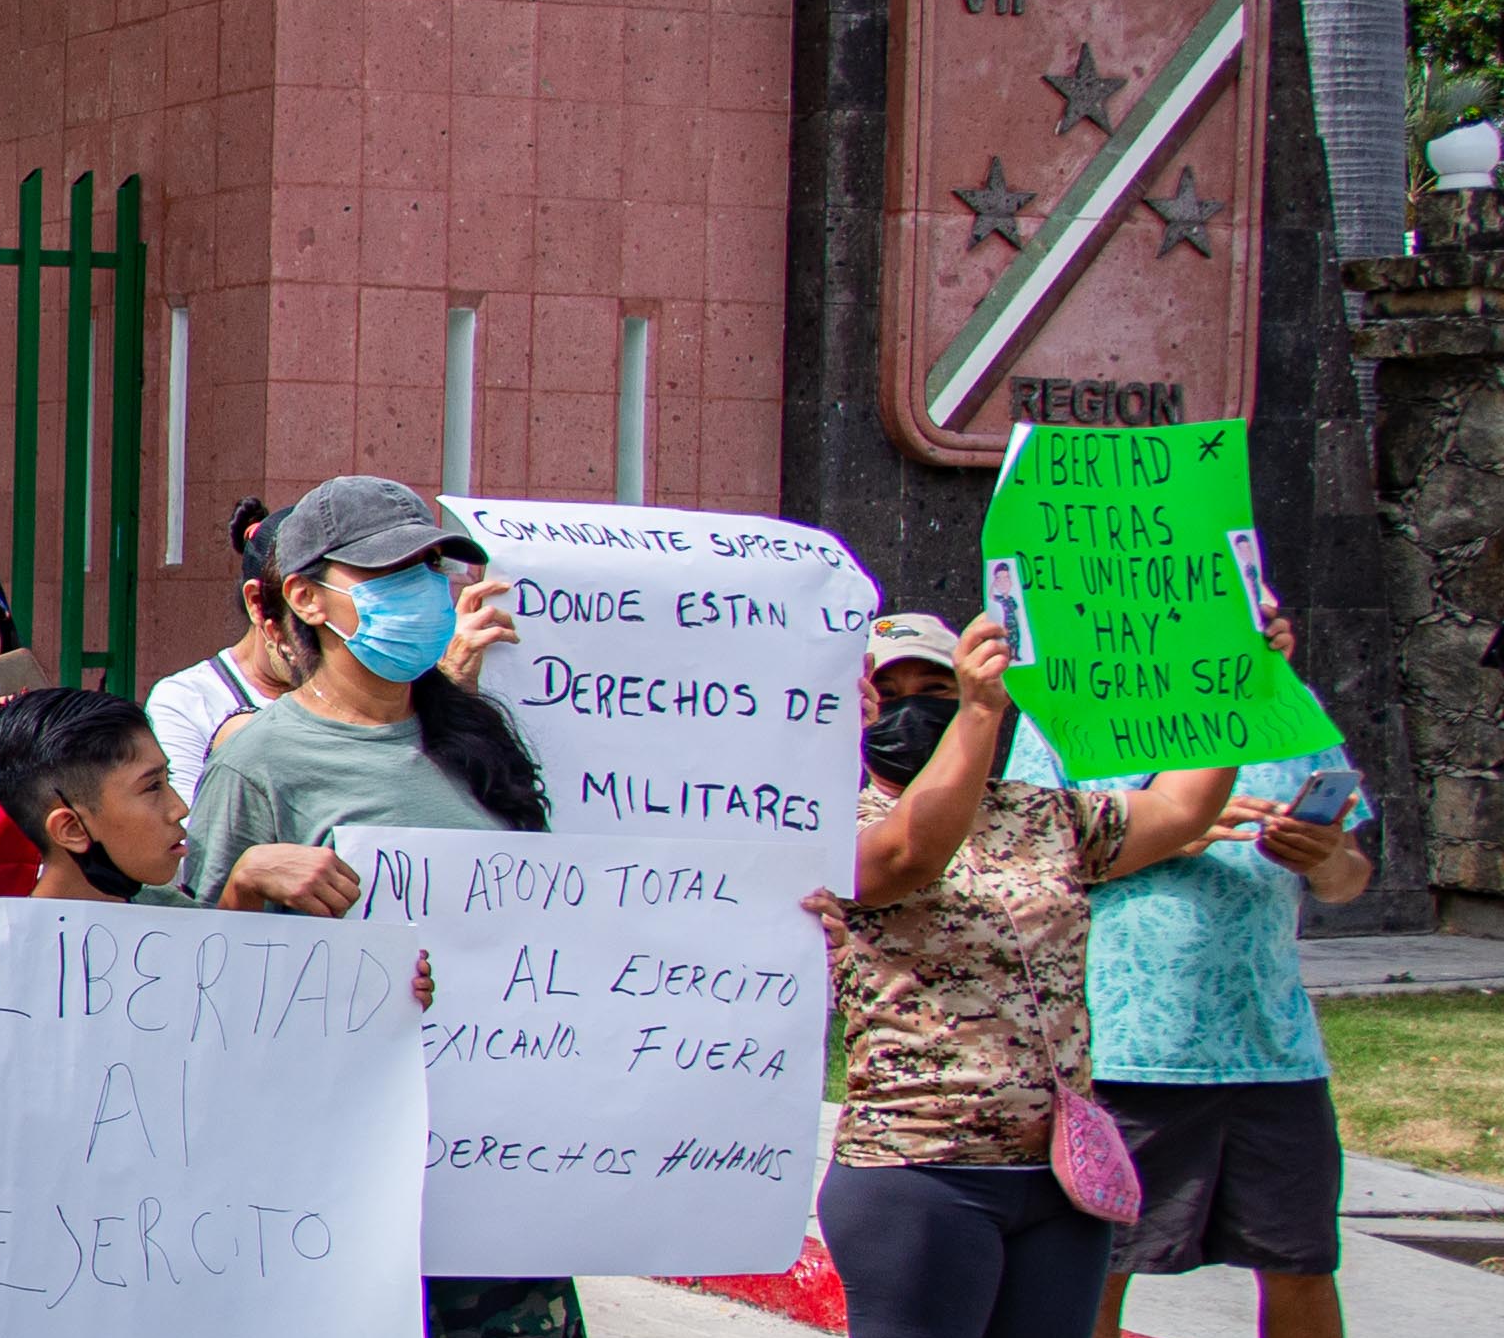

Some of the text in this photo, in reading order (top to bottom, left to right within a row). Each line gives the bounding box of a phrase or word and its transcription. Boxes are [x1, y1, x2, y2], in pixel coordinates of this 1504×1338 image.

[1009, 376, 1185, 427] REGION
[472, 509, 693, 554] COMANDANTE
[1038, 502, 1174, 552] DETRAS
[511, 577, 642, 625] DONDE
[675, 592, 789, 631] ESTAN
[1016, 550, 1228, 604] DEL UNIFORME
[520, 655, 841, 726] DERECHOS DE
[1045, 652, 1254, 701] UN GRAN SER
[1109, 710, 1249, 760] HUMANO
[581, 770, 821, 833] MILITARES
[362, 847, 740, 922] MI APOYO TOTAL
[501, 945, 799, 1009] AL EJERCITO
[627, 1024, 786, 1081] FUERA
[655, 1136, 793, 1182] HUMANOS
